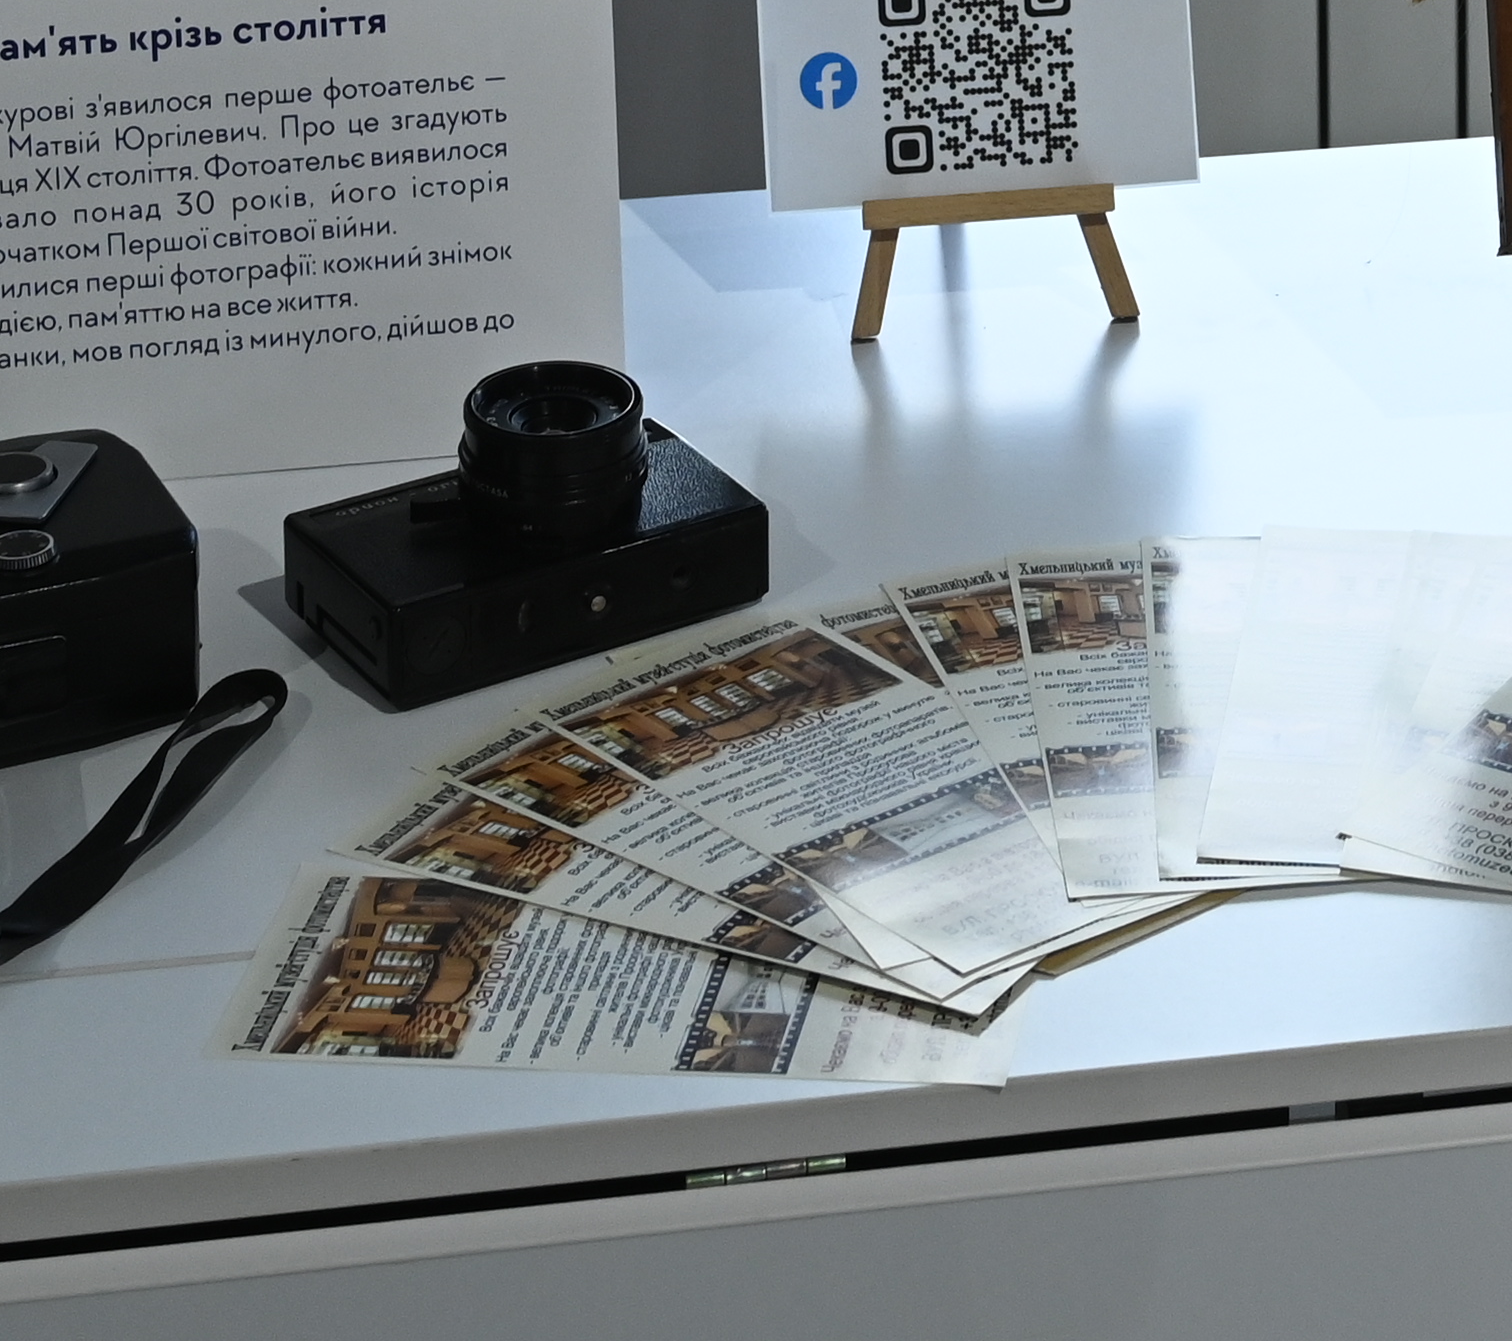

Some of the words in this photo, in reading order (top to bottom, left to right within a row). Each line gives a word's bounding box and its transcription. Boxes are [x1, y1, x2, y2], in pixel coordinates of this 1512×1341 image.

[129, 16, 222, 62] крізь
[232, 6, 386, 44] століття
[85, 93, 212, 118] з'явилося
[224, 86, 312, 114] перше
[323, 75, 474, 109] фотоательє
[8, 130, 100, 159] Матвій
[115, 123, 266, 157] Юргілевич.
[281, 114, 335, 146] Про
[348, 117, 379, 136] це
[391, 108, 507, 135] згадують
[34, 165, 81, 191] XIX
[86, 160, 199, 188] століття.
[204, 152, 365, 180] Фотоательє
[371, 142, 507, 166] виявилося
[1018, 558, 1114, 576] Хмельницький
[721, 706, 839, 755] Запрошує
[465, 929, 520, 1012] Запрошує
